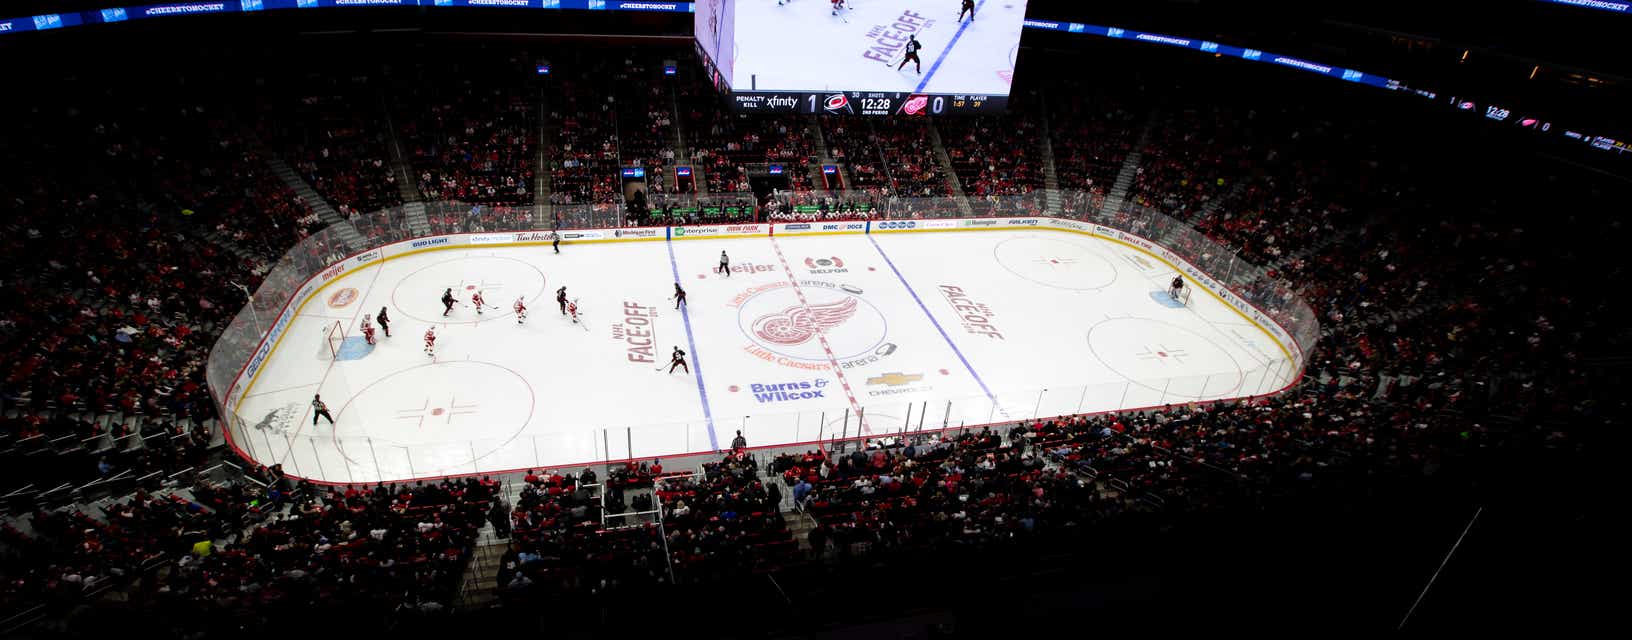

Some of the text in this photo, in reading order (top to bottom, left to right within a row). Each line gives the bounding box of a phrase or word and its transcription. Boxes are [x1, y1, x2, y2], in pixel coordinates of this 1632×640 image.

[766, 95, 798, 109] xfinity
[808, 94, 816, 112] 1
[860, 98, 890, 110] 12:28
[932, 96, 944, 113] 0
[412, 237, 449, 248] BUD LIGHT
[516, 233, 530, 241] Tim
[531, 231, 559, 241] Horto
[322, 263, 345, 281] meijer
[624, 301, 655, 363] FACE-OFF
[247, 342, 270, 379] GEICO
[743, 342, 776, 361] Little
[842, 355, 880, 370] arena
[750, 378, 830, 393] Burns &
[753, 390, 825, 403] Wilcox
